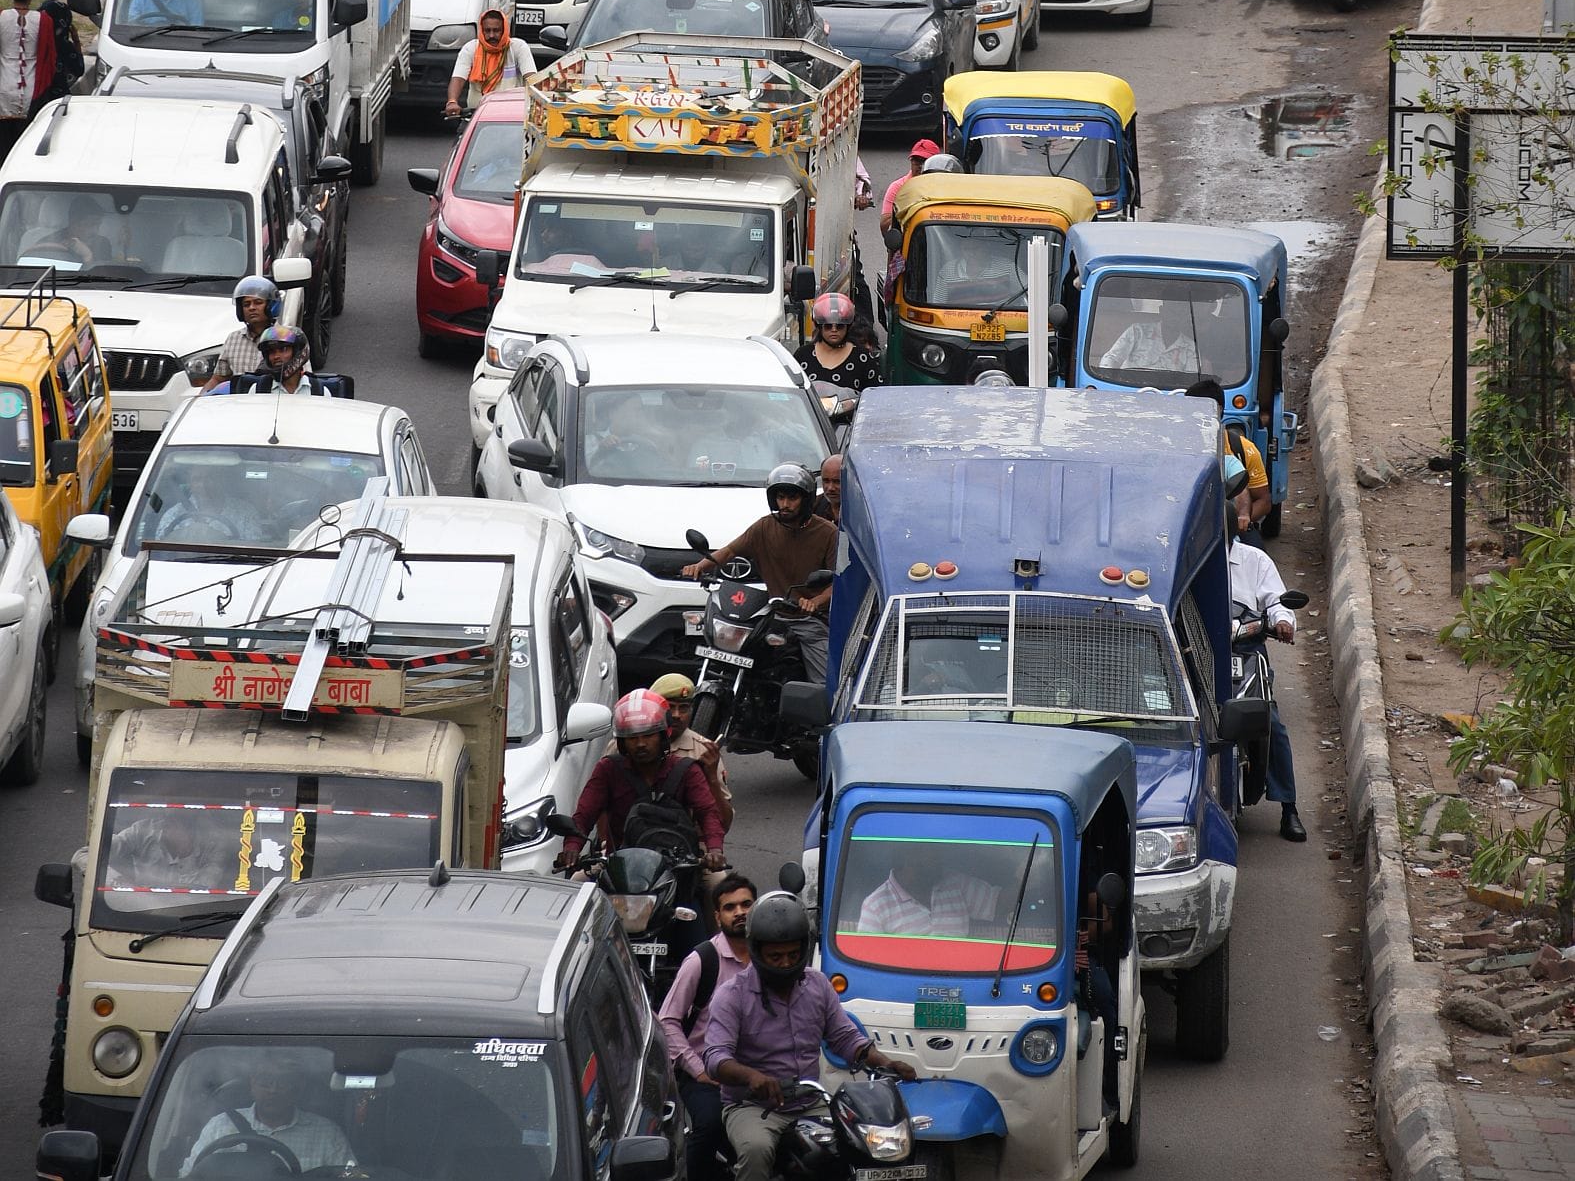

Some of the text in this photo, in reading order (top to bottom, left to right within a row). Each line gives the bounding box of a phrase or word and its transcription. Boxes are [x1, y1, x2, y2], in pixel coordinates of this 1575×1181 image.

[212, 665, 236, 700] श्री
[328, 679, 371, 704] बाबा
[472, 1038, 547, 1055] अधिवक्ता
